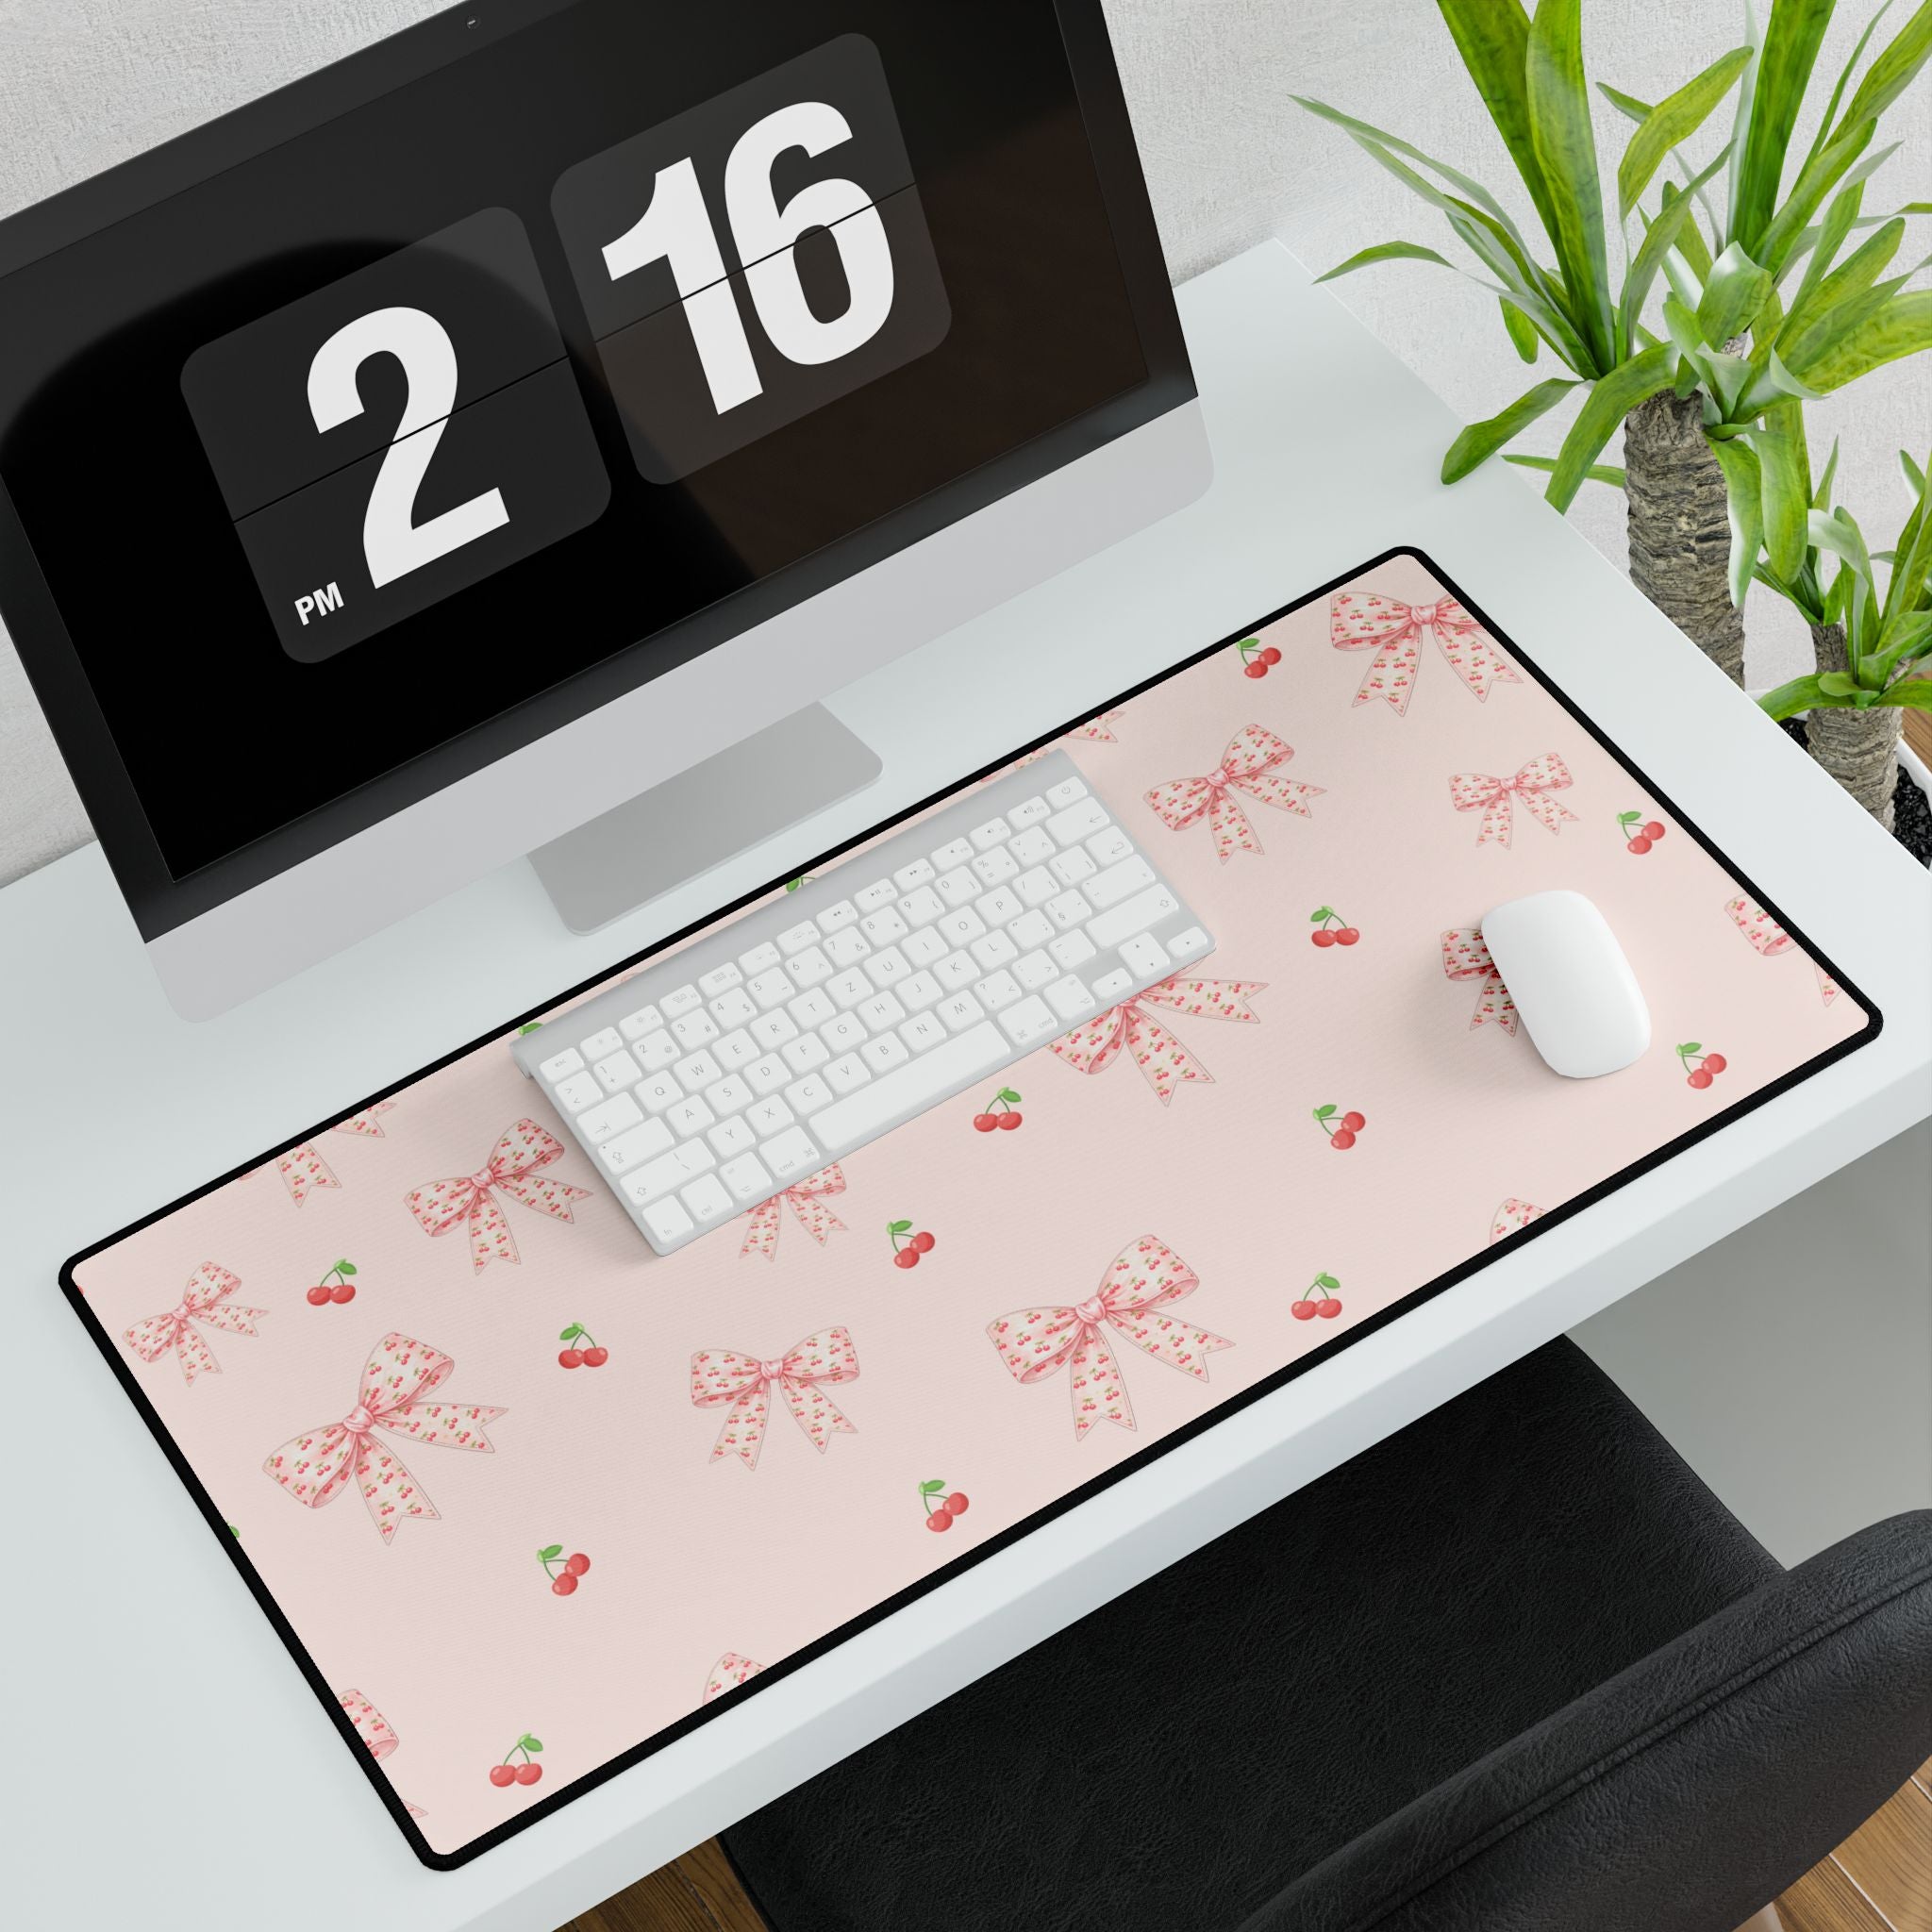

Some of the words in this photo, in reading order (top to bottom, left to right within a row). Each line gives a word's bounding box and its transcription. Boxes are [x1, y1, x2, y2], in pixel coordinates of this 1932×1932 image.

[602, 102, 894, 414] 16
[307, 307, 510, 590] 2
[295, 581, 344, 625] PM
[639, 1044, 648, 1055] 2
[676, 1023, 687, 1033] 3
[717, 1002, 724, 1011] 4
[754, 981, 762, 991] 5
[791, 960, 800, 971] 6
[828, 940, 837, 951] 7
[866, 921, 876, 930] 8
[903, 900, 912, 910] 9
[941, 880, 950, 890] 0
[654, 1086, 666, 1096] Q
[691, 1064, 705, 1076] W
[731, 1044, 741, 1055] E
[770, 1024, 780, 1034] R
[807, 1002, 817, 1013] T
[845, 981, 857, 993] Z
[882, 960, 893, 972] U
[958, 921, 969, 931] O
[994, 900, 1004, 912] P
[685, 1108, 695, 1120] A
[722, 1087, 732, 1098] S
[759, 1066, 771, 1077] D
[799, 1044, 808, 1056] F
[837, 1024, 848, 1035] G
[874, 1003, 886, 1014] H
[914, 982, 923, 993] J
[949, 961, 961, 973] K
[987, 942, 999, 953] L
[724, 1128, 735, 1140] Y
[763, 1107, 776, 1119] X
[803, 1086, 814, 1097] C
[840, 1065, 850, 1076] V
[878, 1045, 890, 1056] B
[916, 1023, 929, 1035] N
[954, 1003, 967, 1015] M
